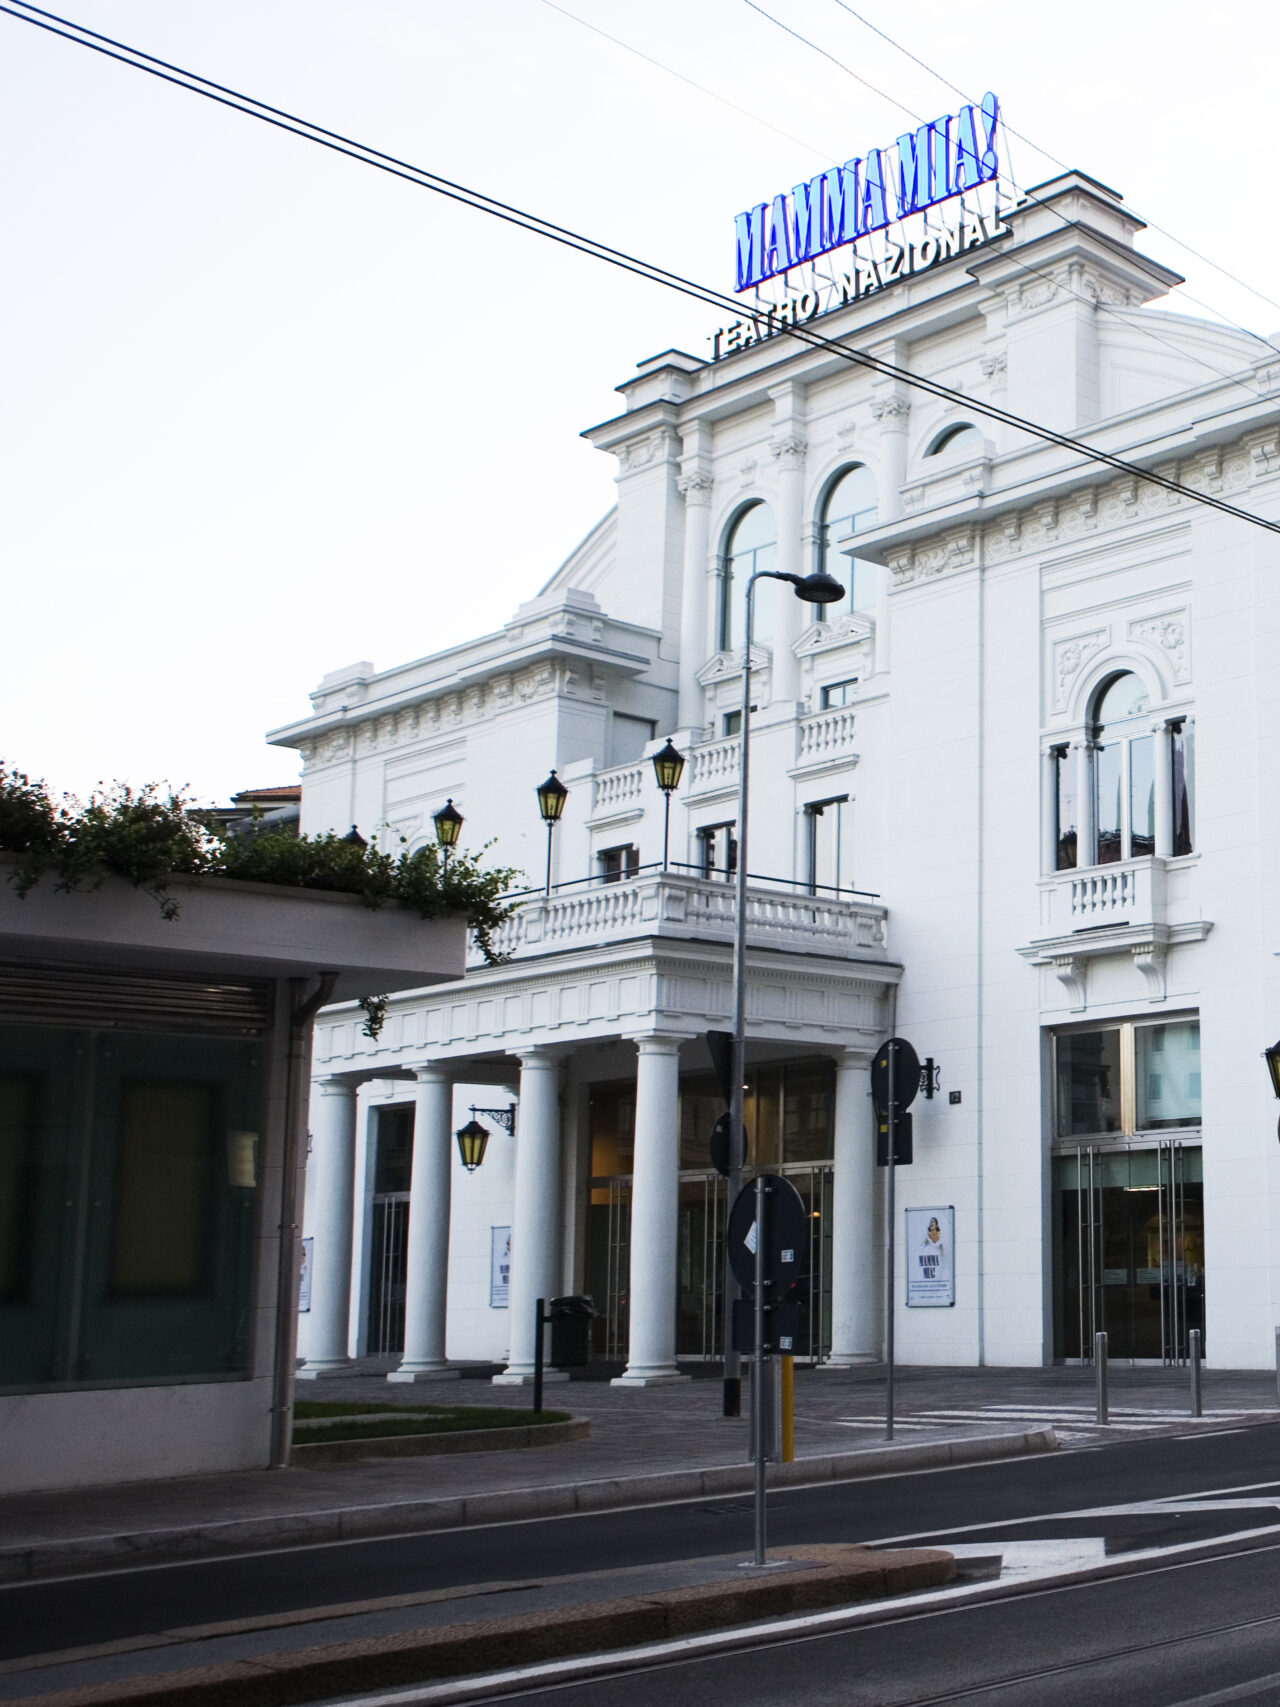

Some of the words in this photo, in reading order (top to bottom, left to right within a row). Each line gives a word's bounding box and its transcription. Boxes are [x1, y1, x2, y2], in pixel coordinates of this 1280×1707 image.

[734, 148, 889, 293] MAMMA
[896, 91, 999, 219] MIA!
[706, 288, 819, 360] TEATRO
